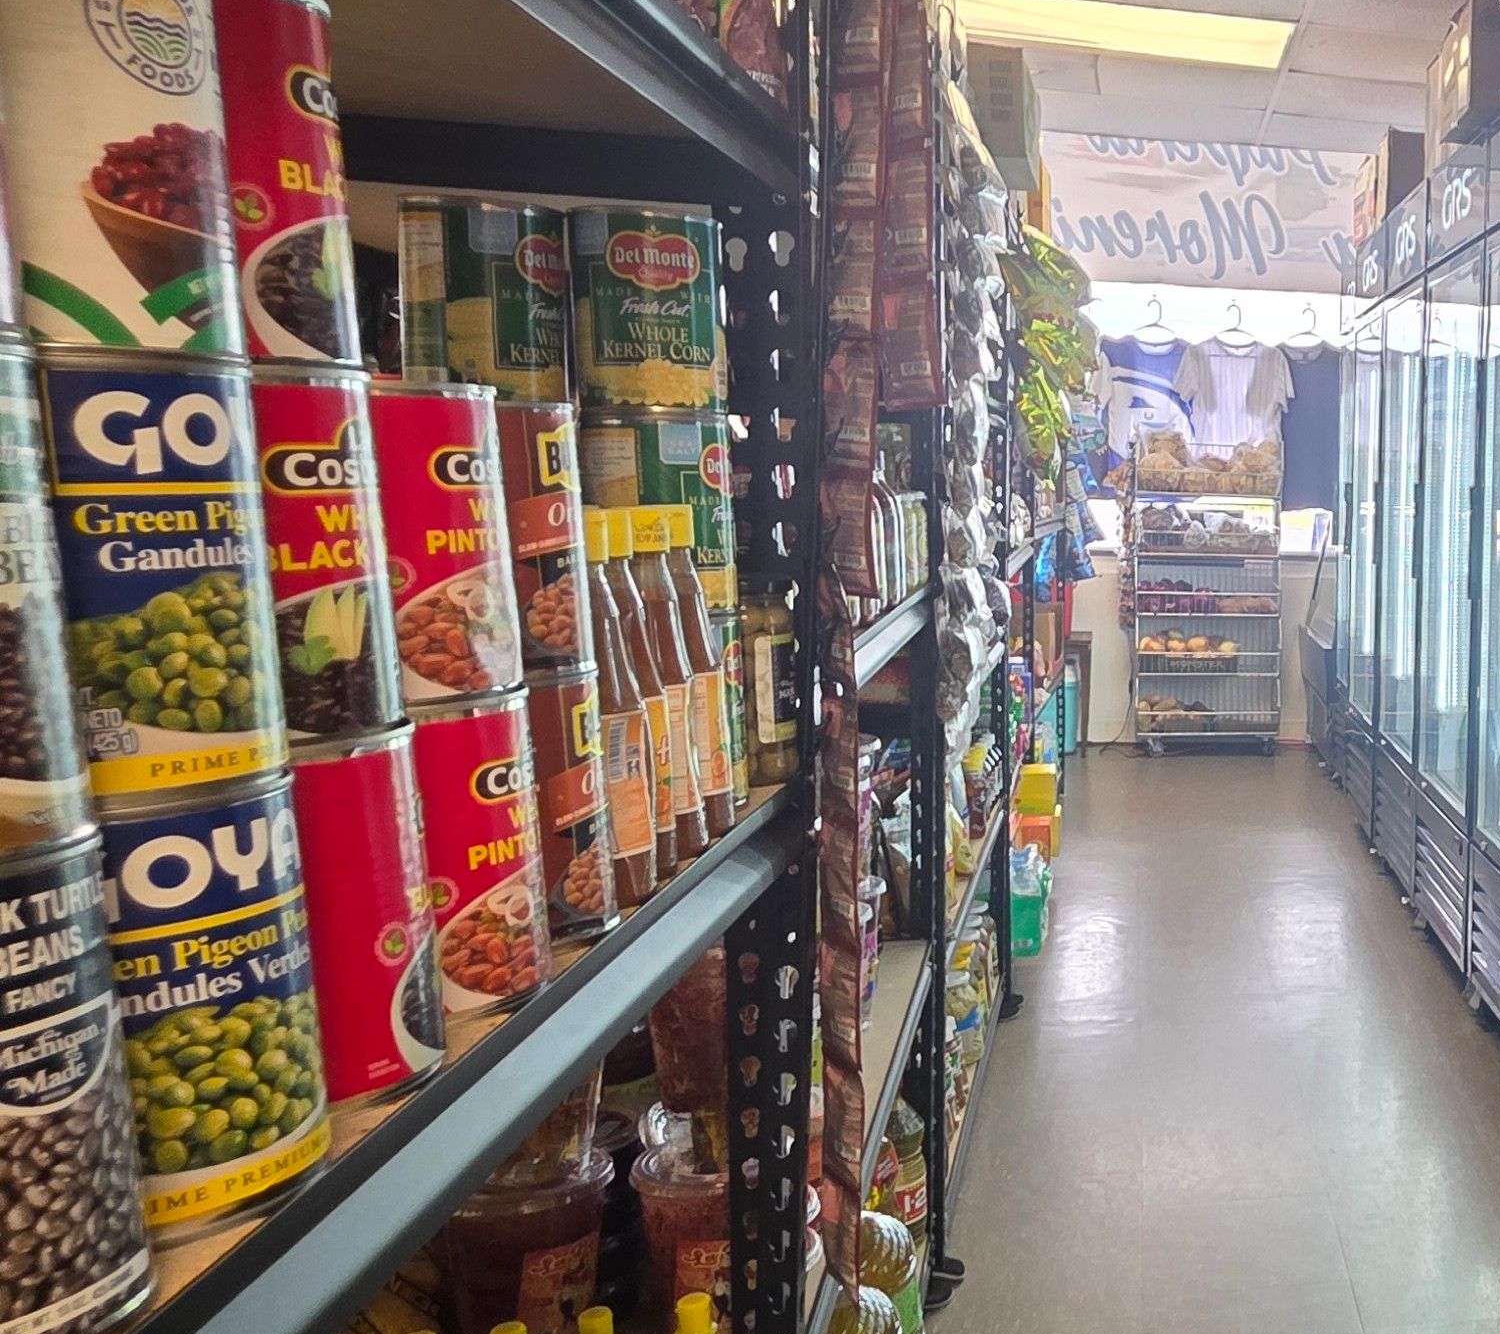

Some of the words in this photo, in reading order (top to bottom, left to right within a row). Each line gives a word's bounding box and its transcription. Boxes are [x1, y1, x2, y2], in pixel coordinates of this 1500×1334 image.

[126, 50, 196, 91] FOODS
[1441, 167, 1473, 230] GRS
[614, 246, 640, 264] Del
[643, 247, 695, 269] Monte
[627, 321, 690, 343] WHOLE
[603, 339, 667, 360] KERNEL
[669, 342, 711, 363] CORN
[73, 502, 197, 537] Green
[99, 539, 252, 573] Gandules
[150, 747, 240, 779] PRIME
[103, 807, 302, 927] OYA
[173, 923, 277, 973] Pigeon
[5, 974, 77, 1015] FANCY
[119, 971, 242, 1018] ndules
[149, 1184, 211, 1215] IME
